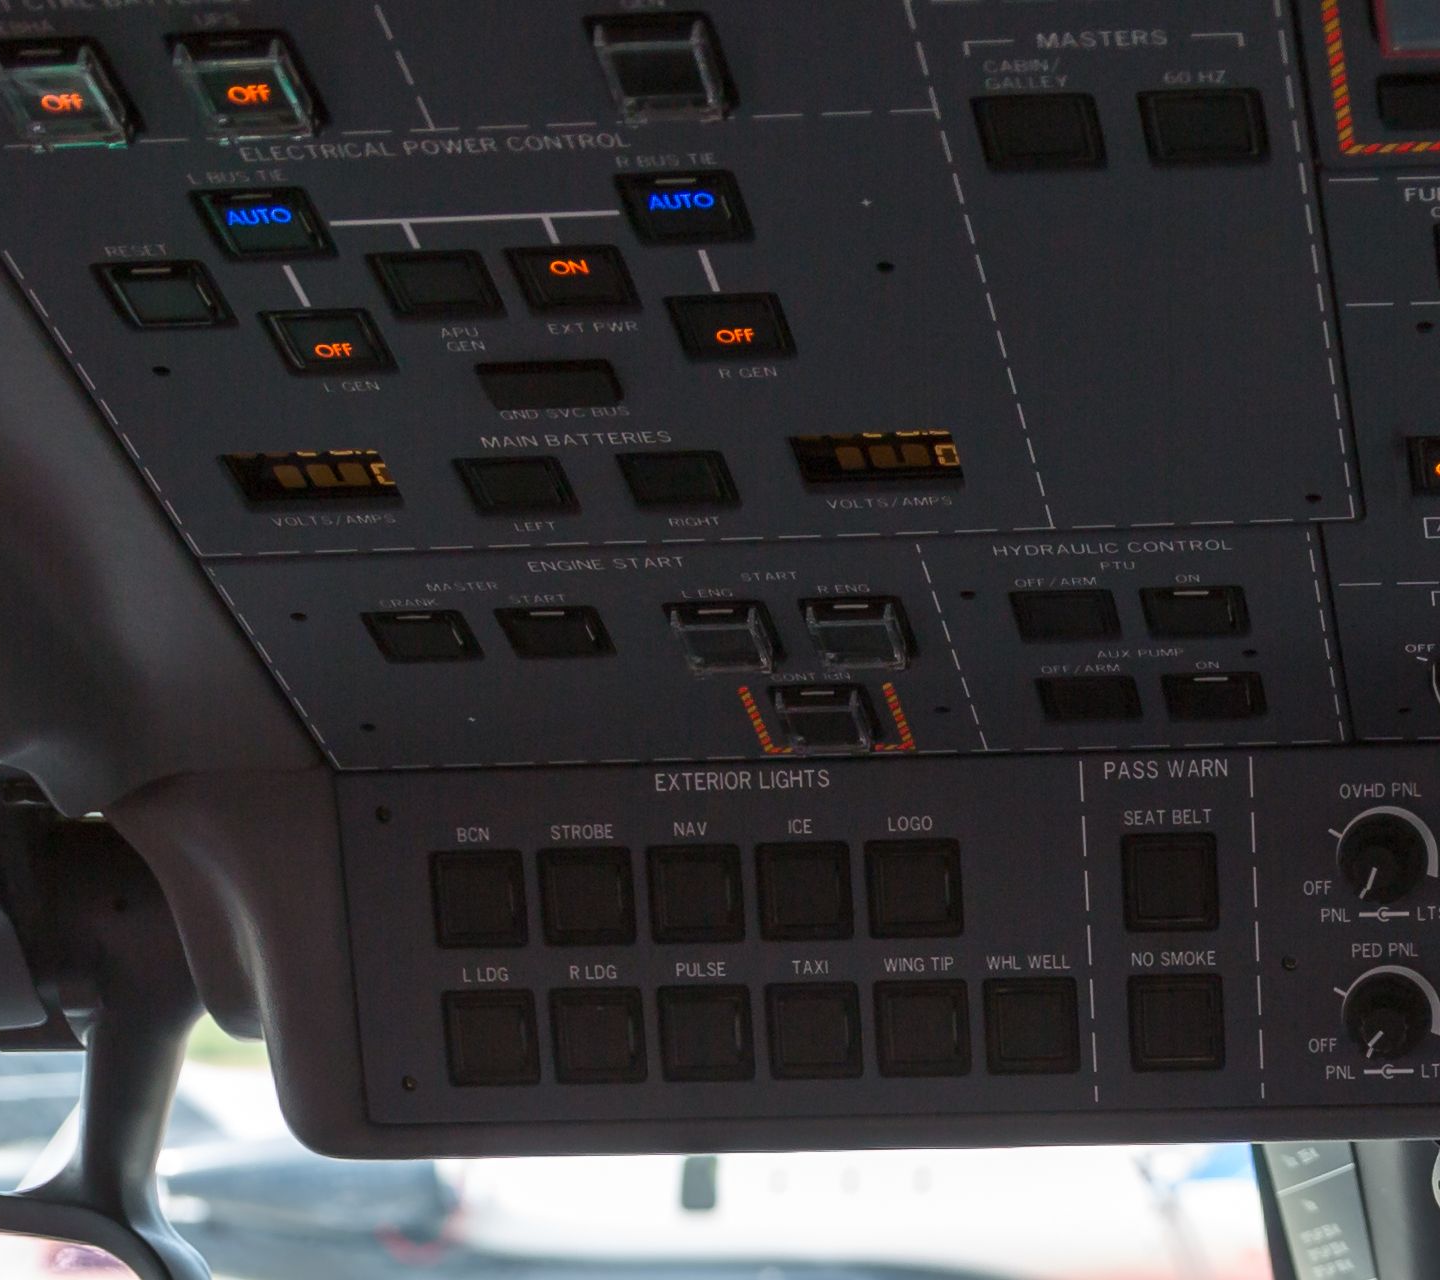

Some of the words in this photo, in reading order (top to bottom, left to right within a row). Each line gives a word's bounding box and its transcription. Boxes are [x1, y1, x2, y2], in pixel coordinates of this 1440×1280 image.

[1036, 29, 1169, 49] MASTERS
[226, 82, 271, 104] OFF
[40, 93, 83, 113] OFF
[239, 140, 394, 163] ELECTRICAL
[401, 136, 500, 157] POWER
[506, 131, 630, 153] CONTROL
[647, 190, 716, 212] AUTO
[225, 205, 293, 227] AUTO
[104, 243, 167, 258] RESET
[548, 258, 591, 276] ON
[547, 322, 585, 336] EXT
[592, 319, 638, 334] PWR
[714, 326, 756, 345] OFF
[313, 341, 353, 359] OFF
[479, 433, 539, 450] MAIN
[545, 429, 673, 448] BATTERIES
[991, 540, 1120, 558] HYDRAULIC
[1126, 539, 1233, 555] CONTROL
[526, 557, 605, 574] ENGINE
[611, 555, 685, 571] START
[1102, 761, 1159, 780] PASS
[1166, 758, 1230, 779] WARN
[654, 771, 753, 793] EXTERIOR
[758, 769, 831, 791] LIGHTS
[1338, 782, 1386, 801] OVHD
[1390, 781, 1423, 799] PNL
[887, 815, 934, 833] LOGO
[1122, 809, 1167, 826] SEAT
[1172, 808, 1213, 825] BELT
[455, 826, 490, 844] BCN
[549, 823, 614, 841] STROBE
[672, 821, 708, 838] NAV
[787, 818, 813, 835] ICE
[1130, 951, 1154, 967] NO
[1160, 950, 1217, 967] SMOKE
[1350, 942, 1384, 959] PED
[1387, 941, 1419, 957] PNL
[675, 961, 727, 978] PULSE
[791, 959, 830, 976] TAXI
[882, 956, 926, 974] WING
[927, 955, 955, 973] TIP
[986, 954, 1022, 971] WHL
[1026, 953, 1072, 971] WELL
